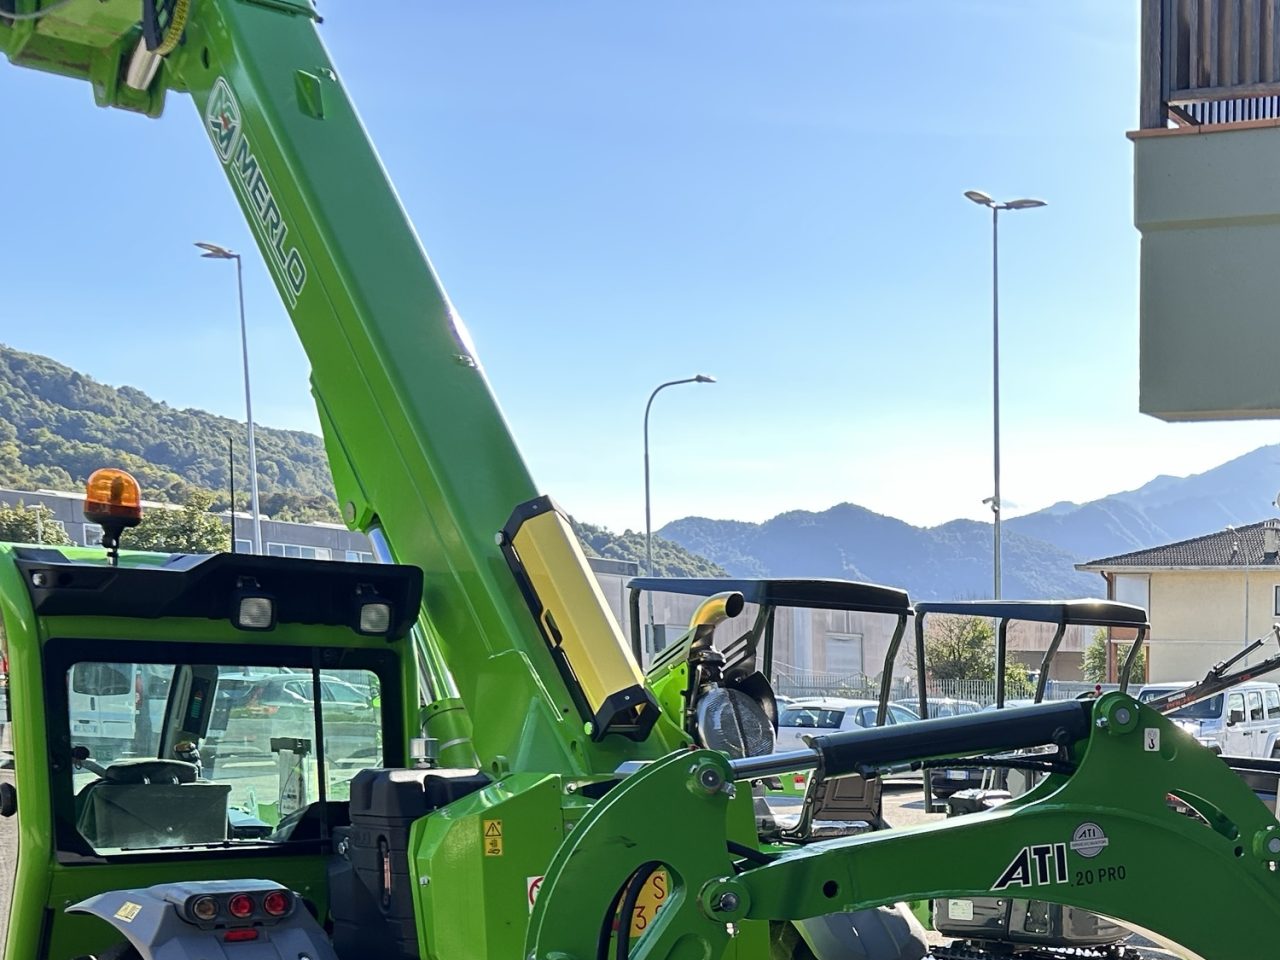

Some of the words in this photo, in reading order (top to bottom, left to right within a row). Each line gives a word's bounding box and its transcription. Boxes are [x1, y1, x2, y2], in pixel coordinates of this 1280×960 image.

[235, 134, 306, 295] MERLO
[1078, 828, 1096, 839] ATI
[990, 843, 1069, 891] ATI
[1098, 865, 1126, 883] PRO
